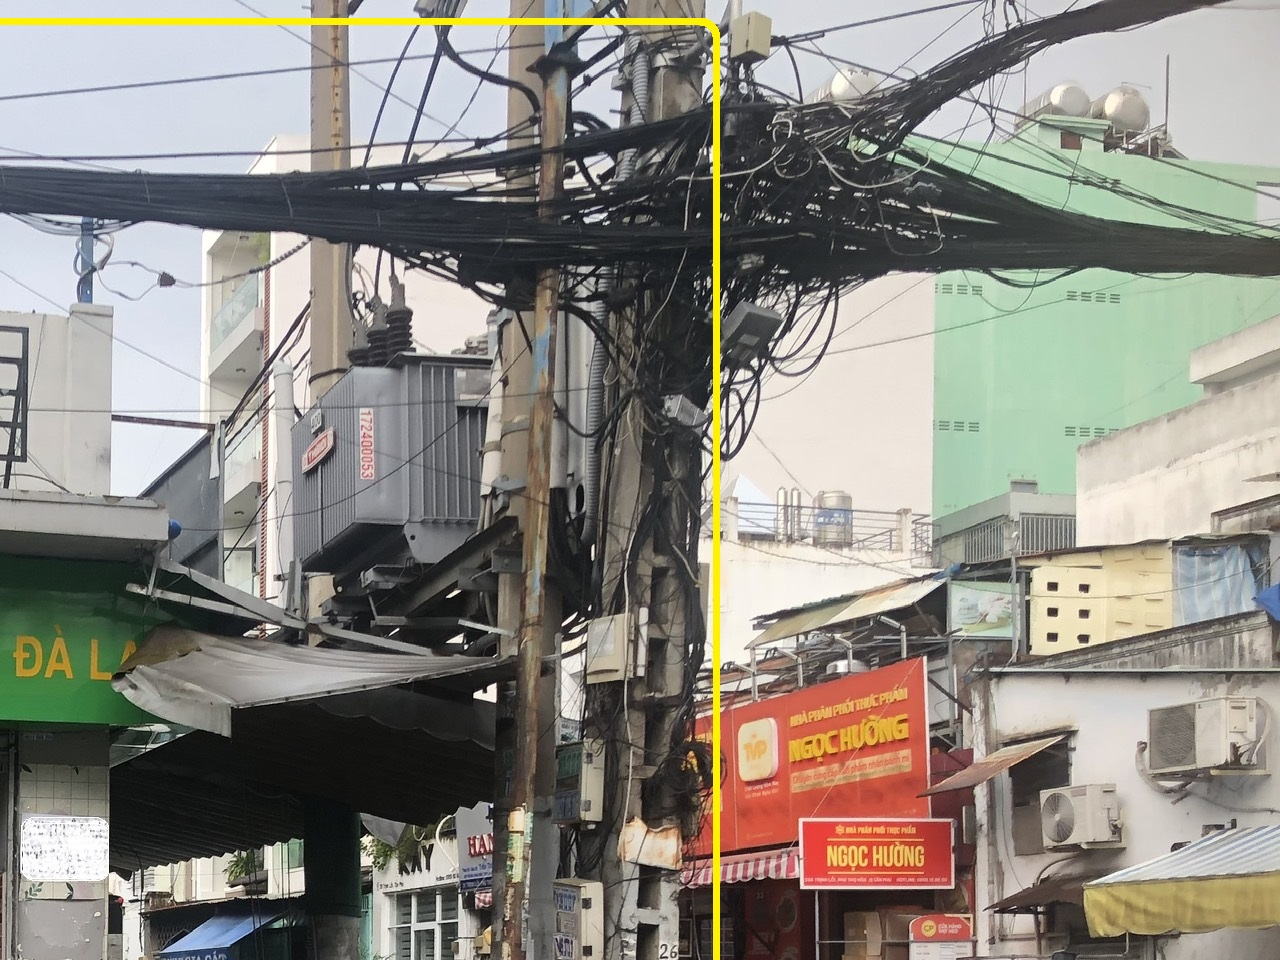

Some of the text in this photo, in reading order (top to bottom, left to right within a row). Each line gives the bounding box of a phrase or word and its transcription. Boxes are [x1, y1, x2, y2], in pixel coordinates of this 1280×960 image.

[13, 624, 74, 680] ĐÀ
[789, 714, 910, 763] NGỌC HƯỜNG
[827, 841, 925, 872] NGỌC HƯỜNG
[660, 943, 678, 960] 26
